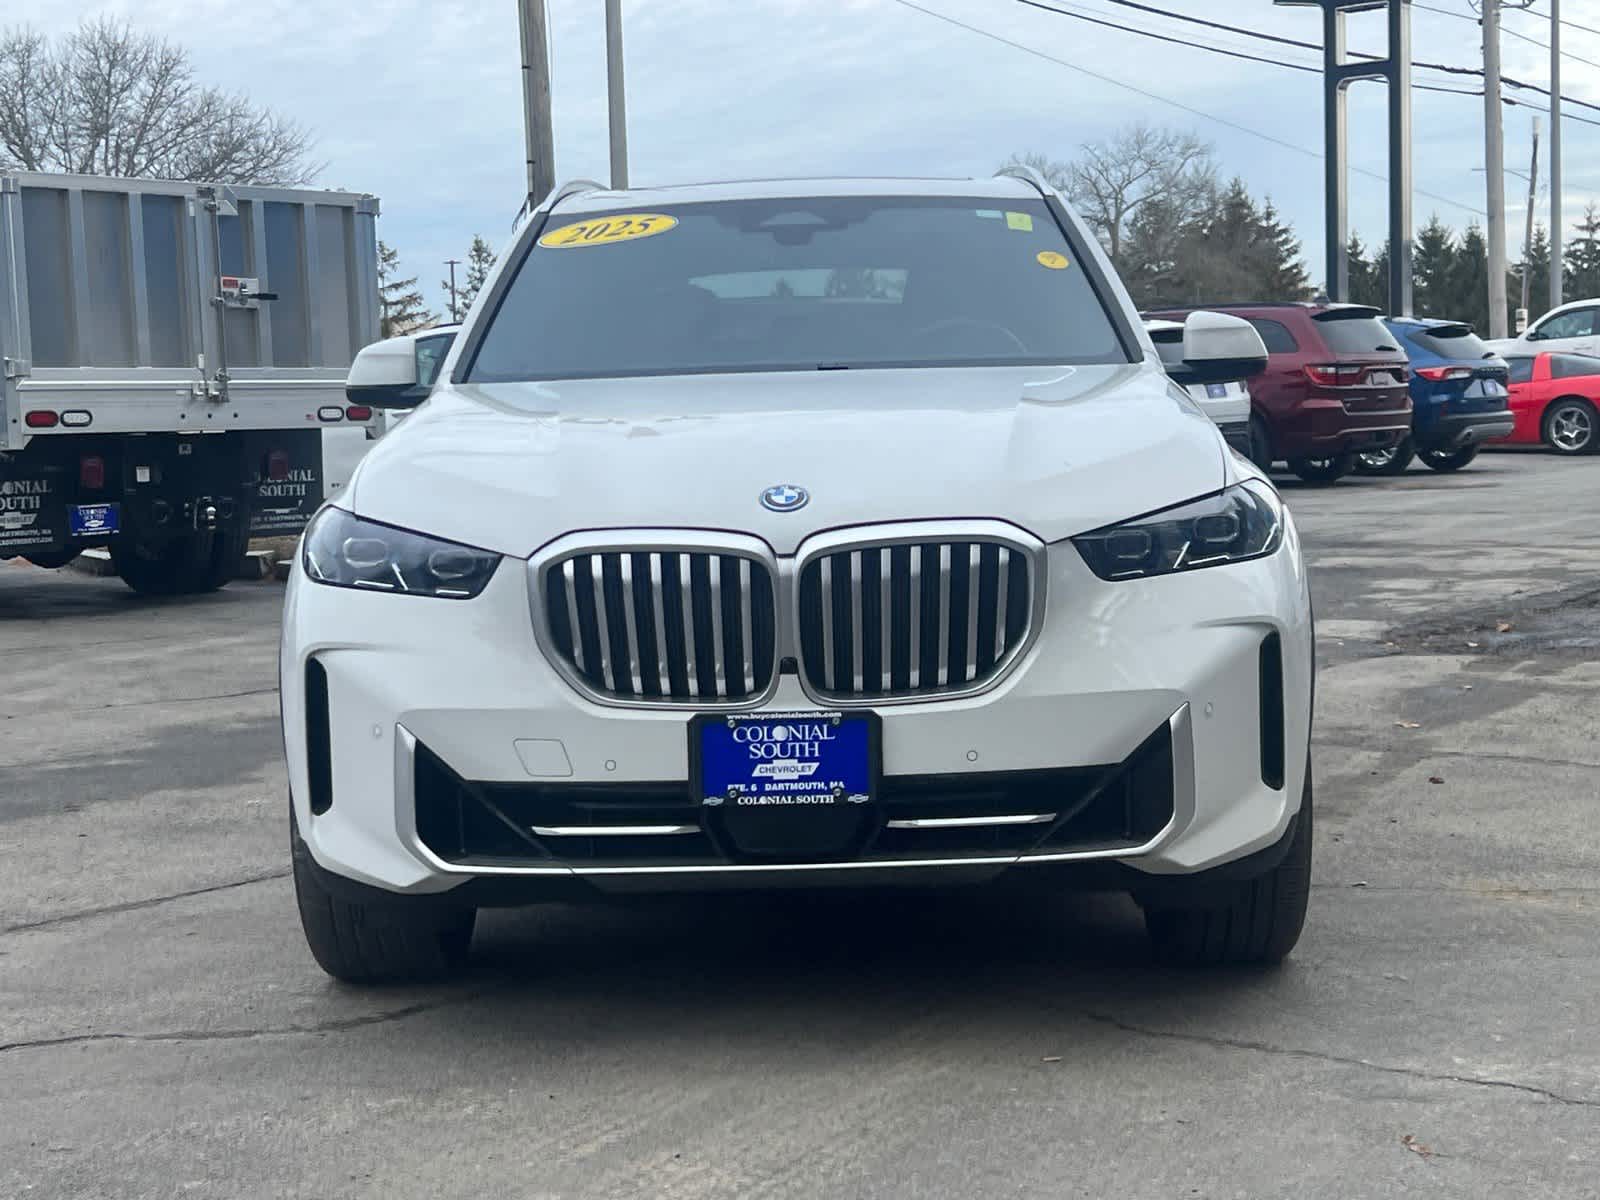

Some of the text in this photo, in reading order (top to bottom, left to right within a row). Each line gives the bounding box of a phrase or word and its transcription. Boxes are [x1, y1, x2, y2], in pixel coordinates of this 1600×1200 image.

[560, 217, 657, 244] 2025
[259, 484, 306, 496] SOUTH
[733, 724, 835, 743] COLONIAL
[749, 742, 820, 759] SOUTH
[758, 765, 812, 774] CHEVROLET
[764, 781, 828, 792] DARTMOUTH,
[737, 794, 834, 806] COLONIAL SOUTH
